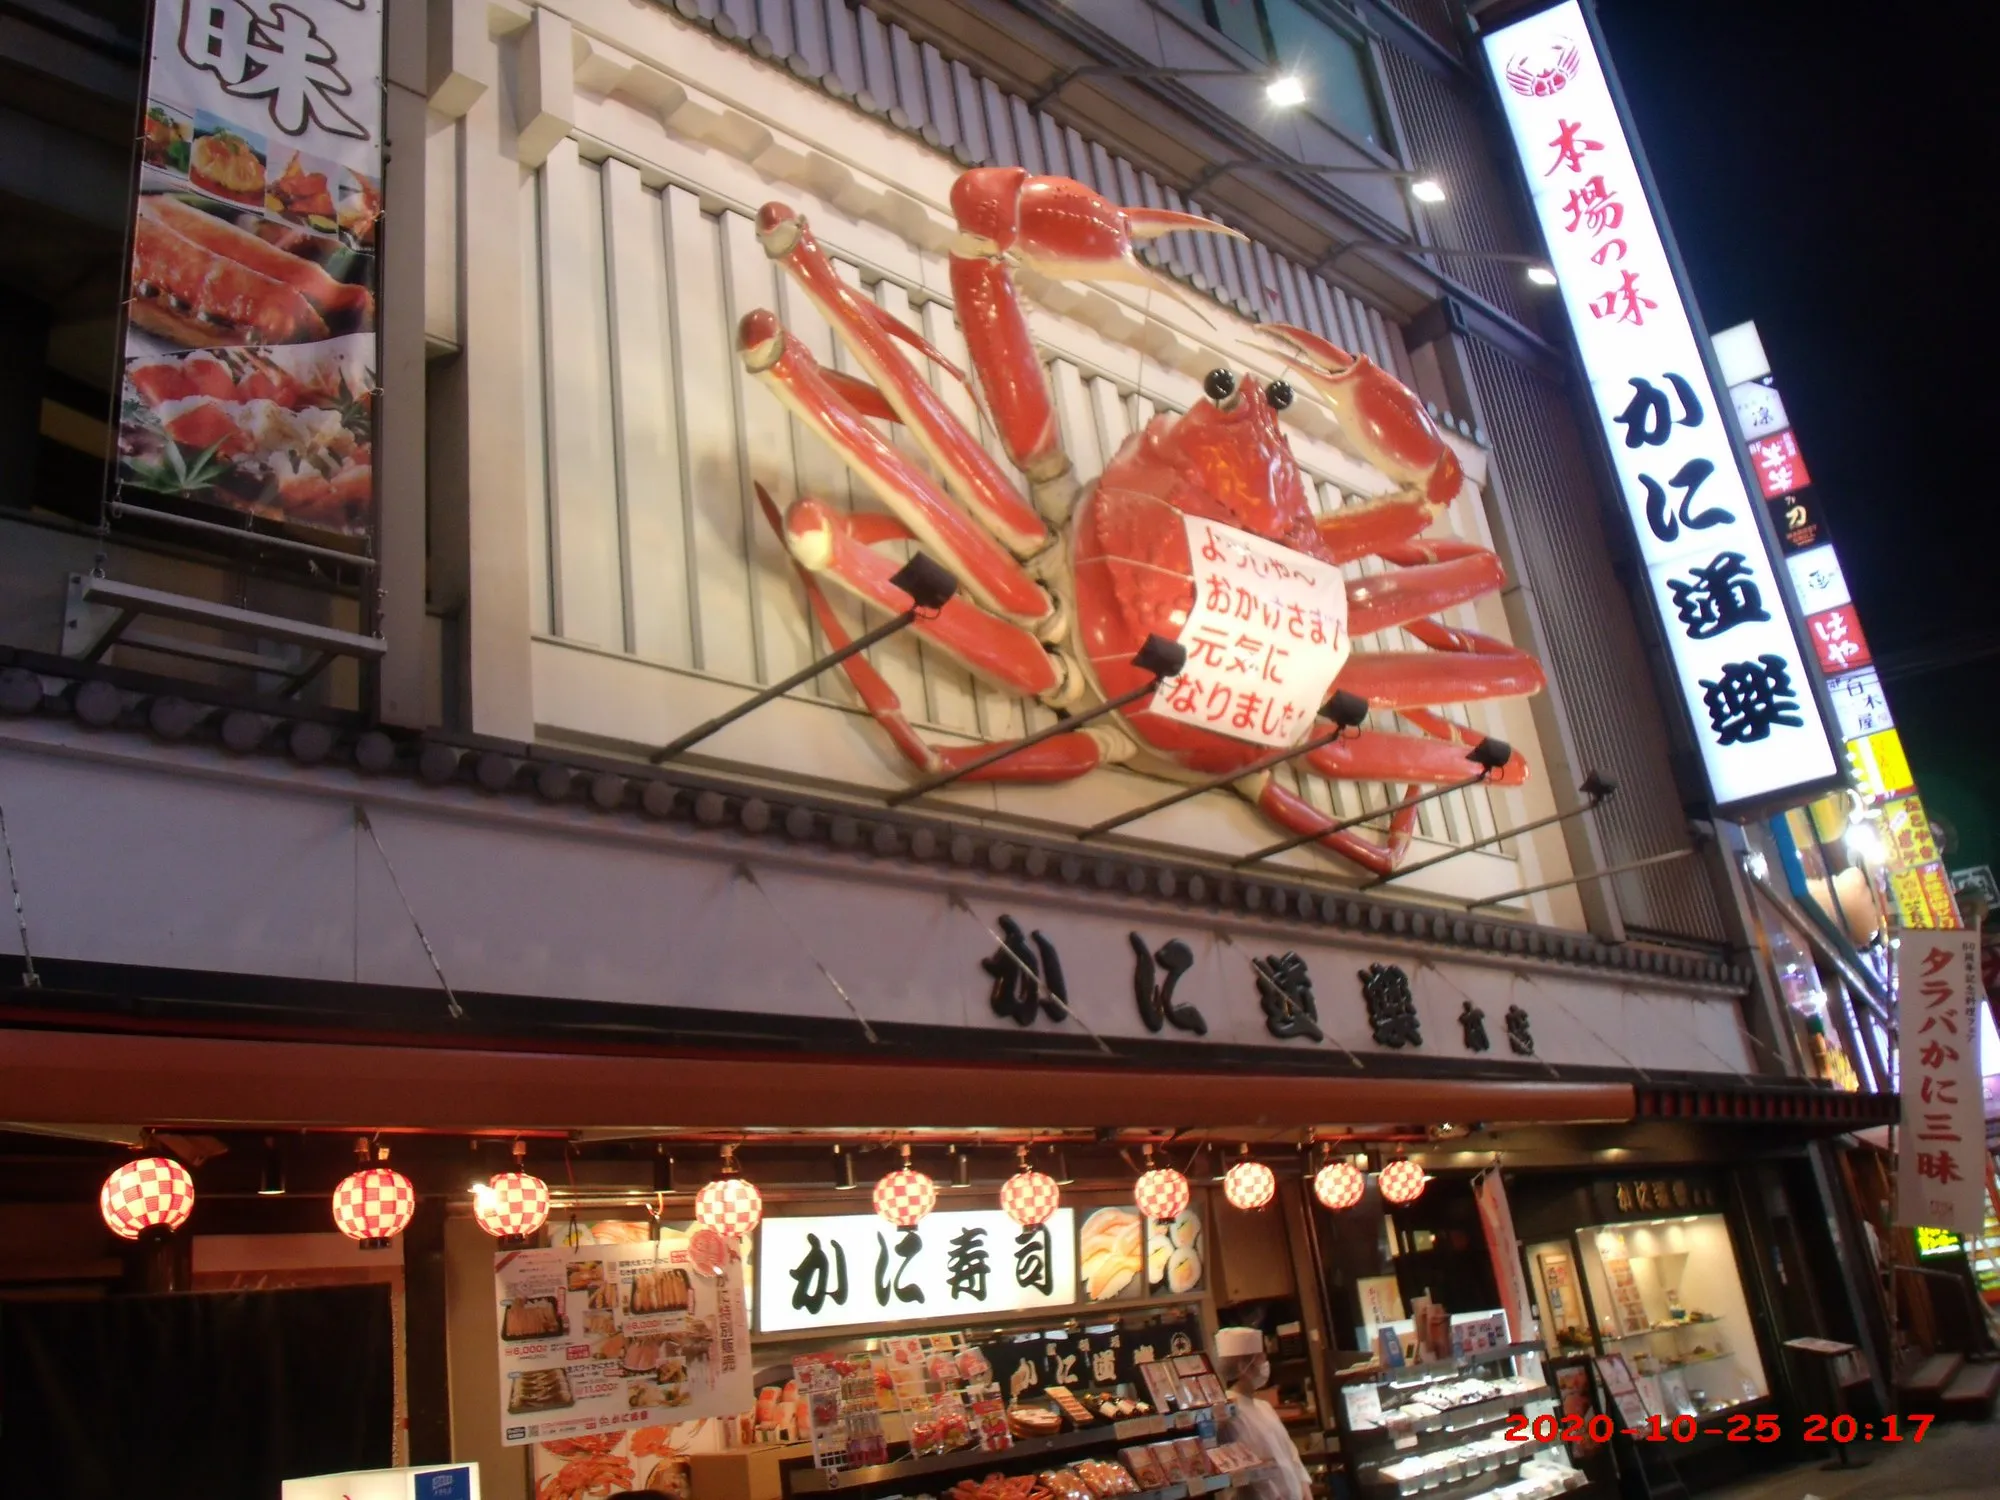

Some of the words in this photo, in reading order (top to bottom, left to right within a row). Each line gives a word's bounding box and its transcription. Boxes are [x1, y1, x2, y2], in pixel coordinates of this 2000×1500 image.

[1544, 119, 1658, 327] 本場の味
[1187, 625, 1291, 685] 元気に
[1847, 677, 1884, 730] 白木屋
[789, 1226, 1055, 1316] かに寿司
